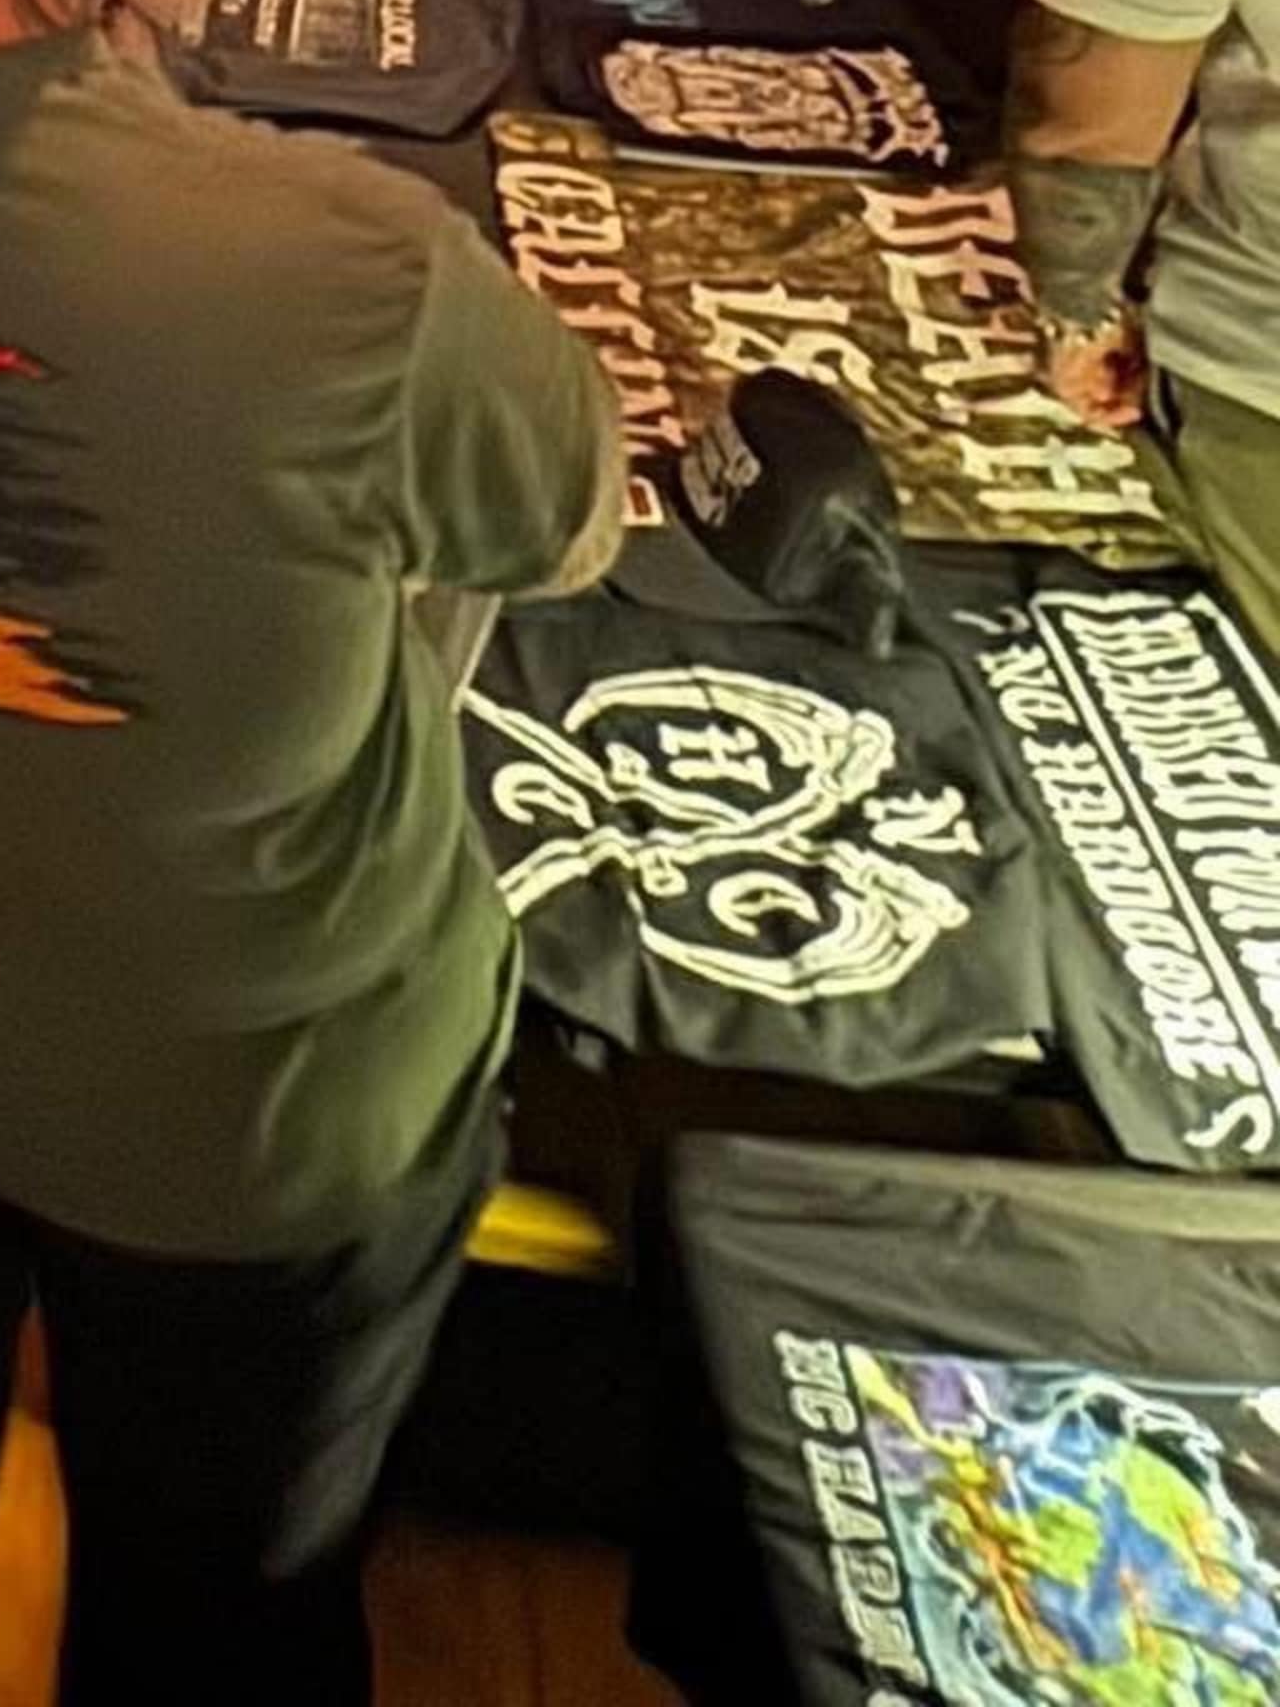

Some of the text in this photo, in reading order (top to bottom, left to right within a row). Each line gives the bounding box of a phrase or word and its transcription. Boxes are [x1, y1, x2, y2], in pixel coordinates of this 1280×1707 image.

[690, 282, 880, 395] IS
[854, 185, 1167, 521] DEATH
[1020, 736, 1263, 1088] HARDCORE
